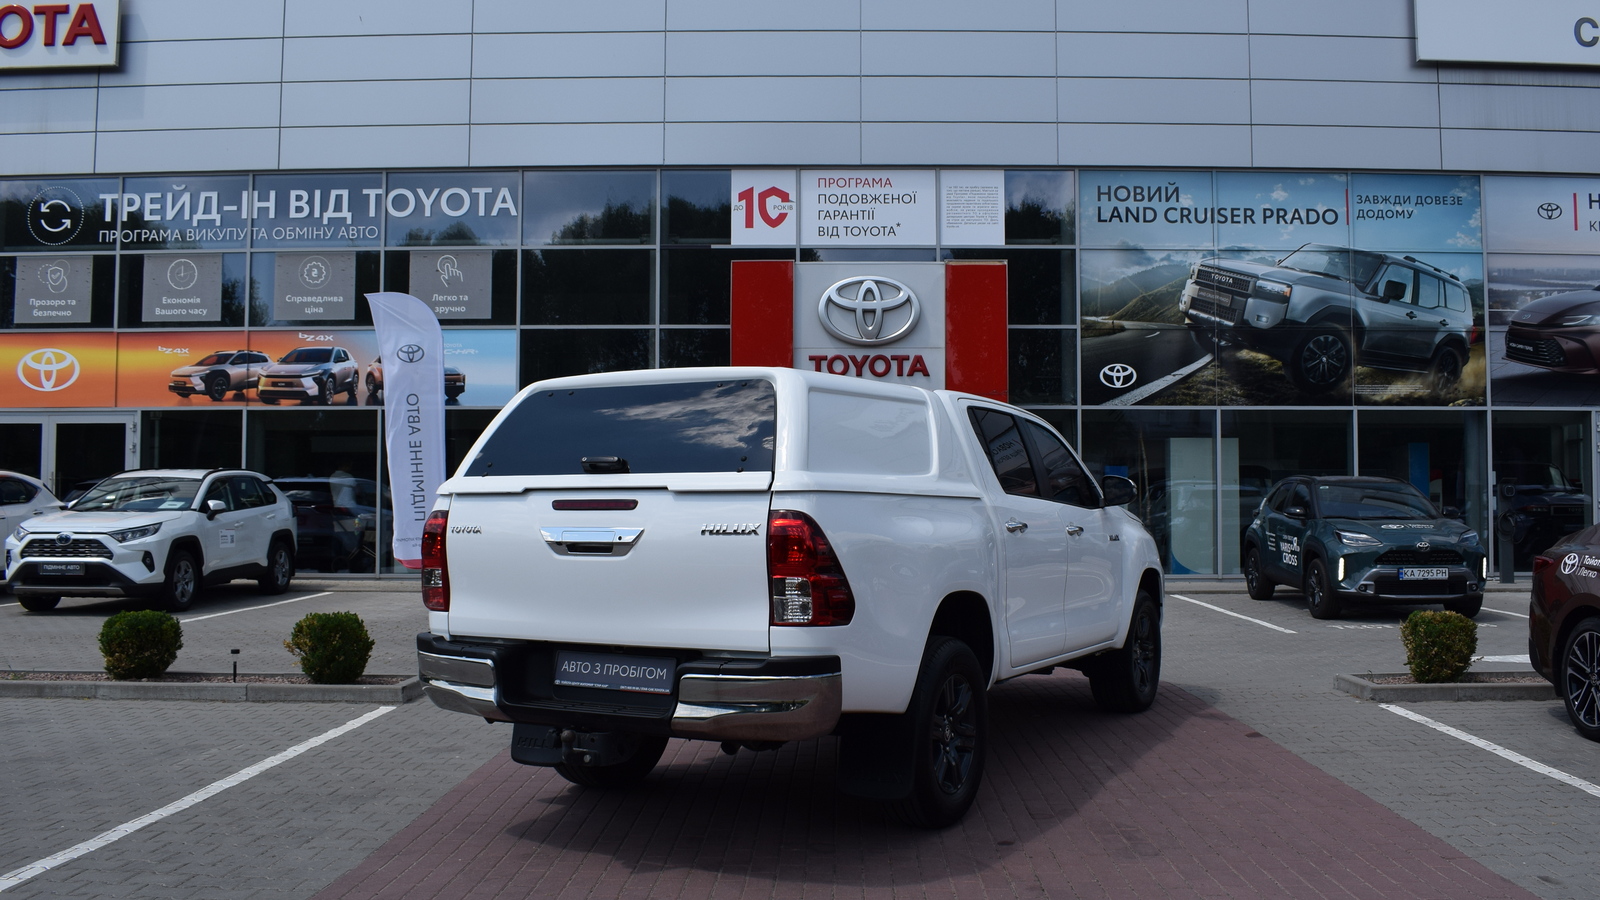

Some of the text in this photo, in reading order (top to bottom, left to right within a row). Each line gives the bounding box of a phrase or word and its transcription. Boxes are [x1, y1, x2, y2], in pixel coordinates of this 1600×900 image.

[818, 177, 893, 188] ПРОГРАМА
[1097, 182, 1180, 203] НОВИЙ
[818, 191, 917, 206] ПОДОВЖЕНОЇ
[1356, 195, 1463, 206] ЗАВЖДИ ДОВЕЗЕ
[99, 184, 518, 226] ТРЕЙД-ІН ВІД TOYOTA
[818, 207, 875, 220] ГАРАНТІЇ
[1097, 207, 1339, 225] LAND CRUISER PRADO
[1356, 209, 1414, 220] ДОДОМУ
[99, 225, 379, 242] ПРОГРАМА ВИКУПУ ТА ОБМІНУ АВТО
[818, 226, 840, 239] ВІД
[1211, 273, 1233, 284] TOYOTA
[30, 298, 65, 307] Прозоро
[162, 296, 201, 304] Економія
[285, 294, 343, 303] Справедлива
[432, 294, 457, 302] Легко
[33, 308, 72, 317] безпечно
[155, 307, 208, 316] Вашого часу
[304, 304, 323, 314] ціна
[434, 305, 466, 313] зручно
[809, 354, 930, 377] TOYOTA
[450, 526, 481, 534] TOYOTA
[701, 523, 762, 536] HILUX
[1283, 552, 1297, 566] CROSS
[1403, 569, 1447, 578] KA 7295 PH
[561, 660, 591, 674] АВТО
[603, 663, 667, 680] ПРОБІГОМ
